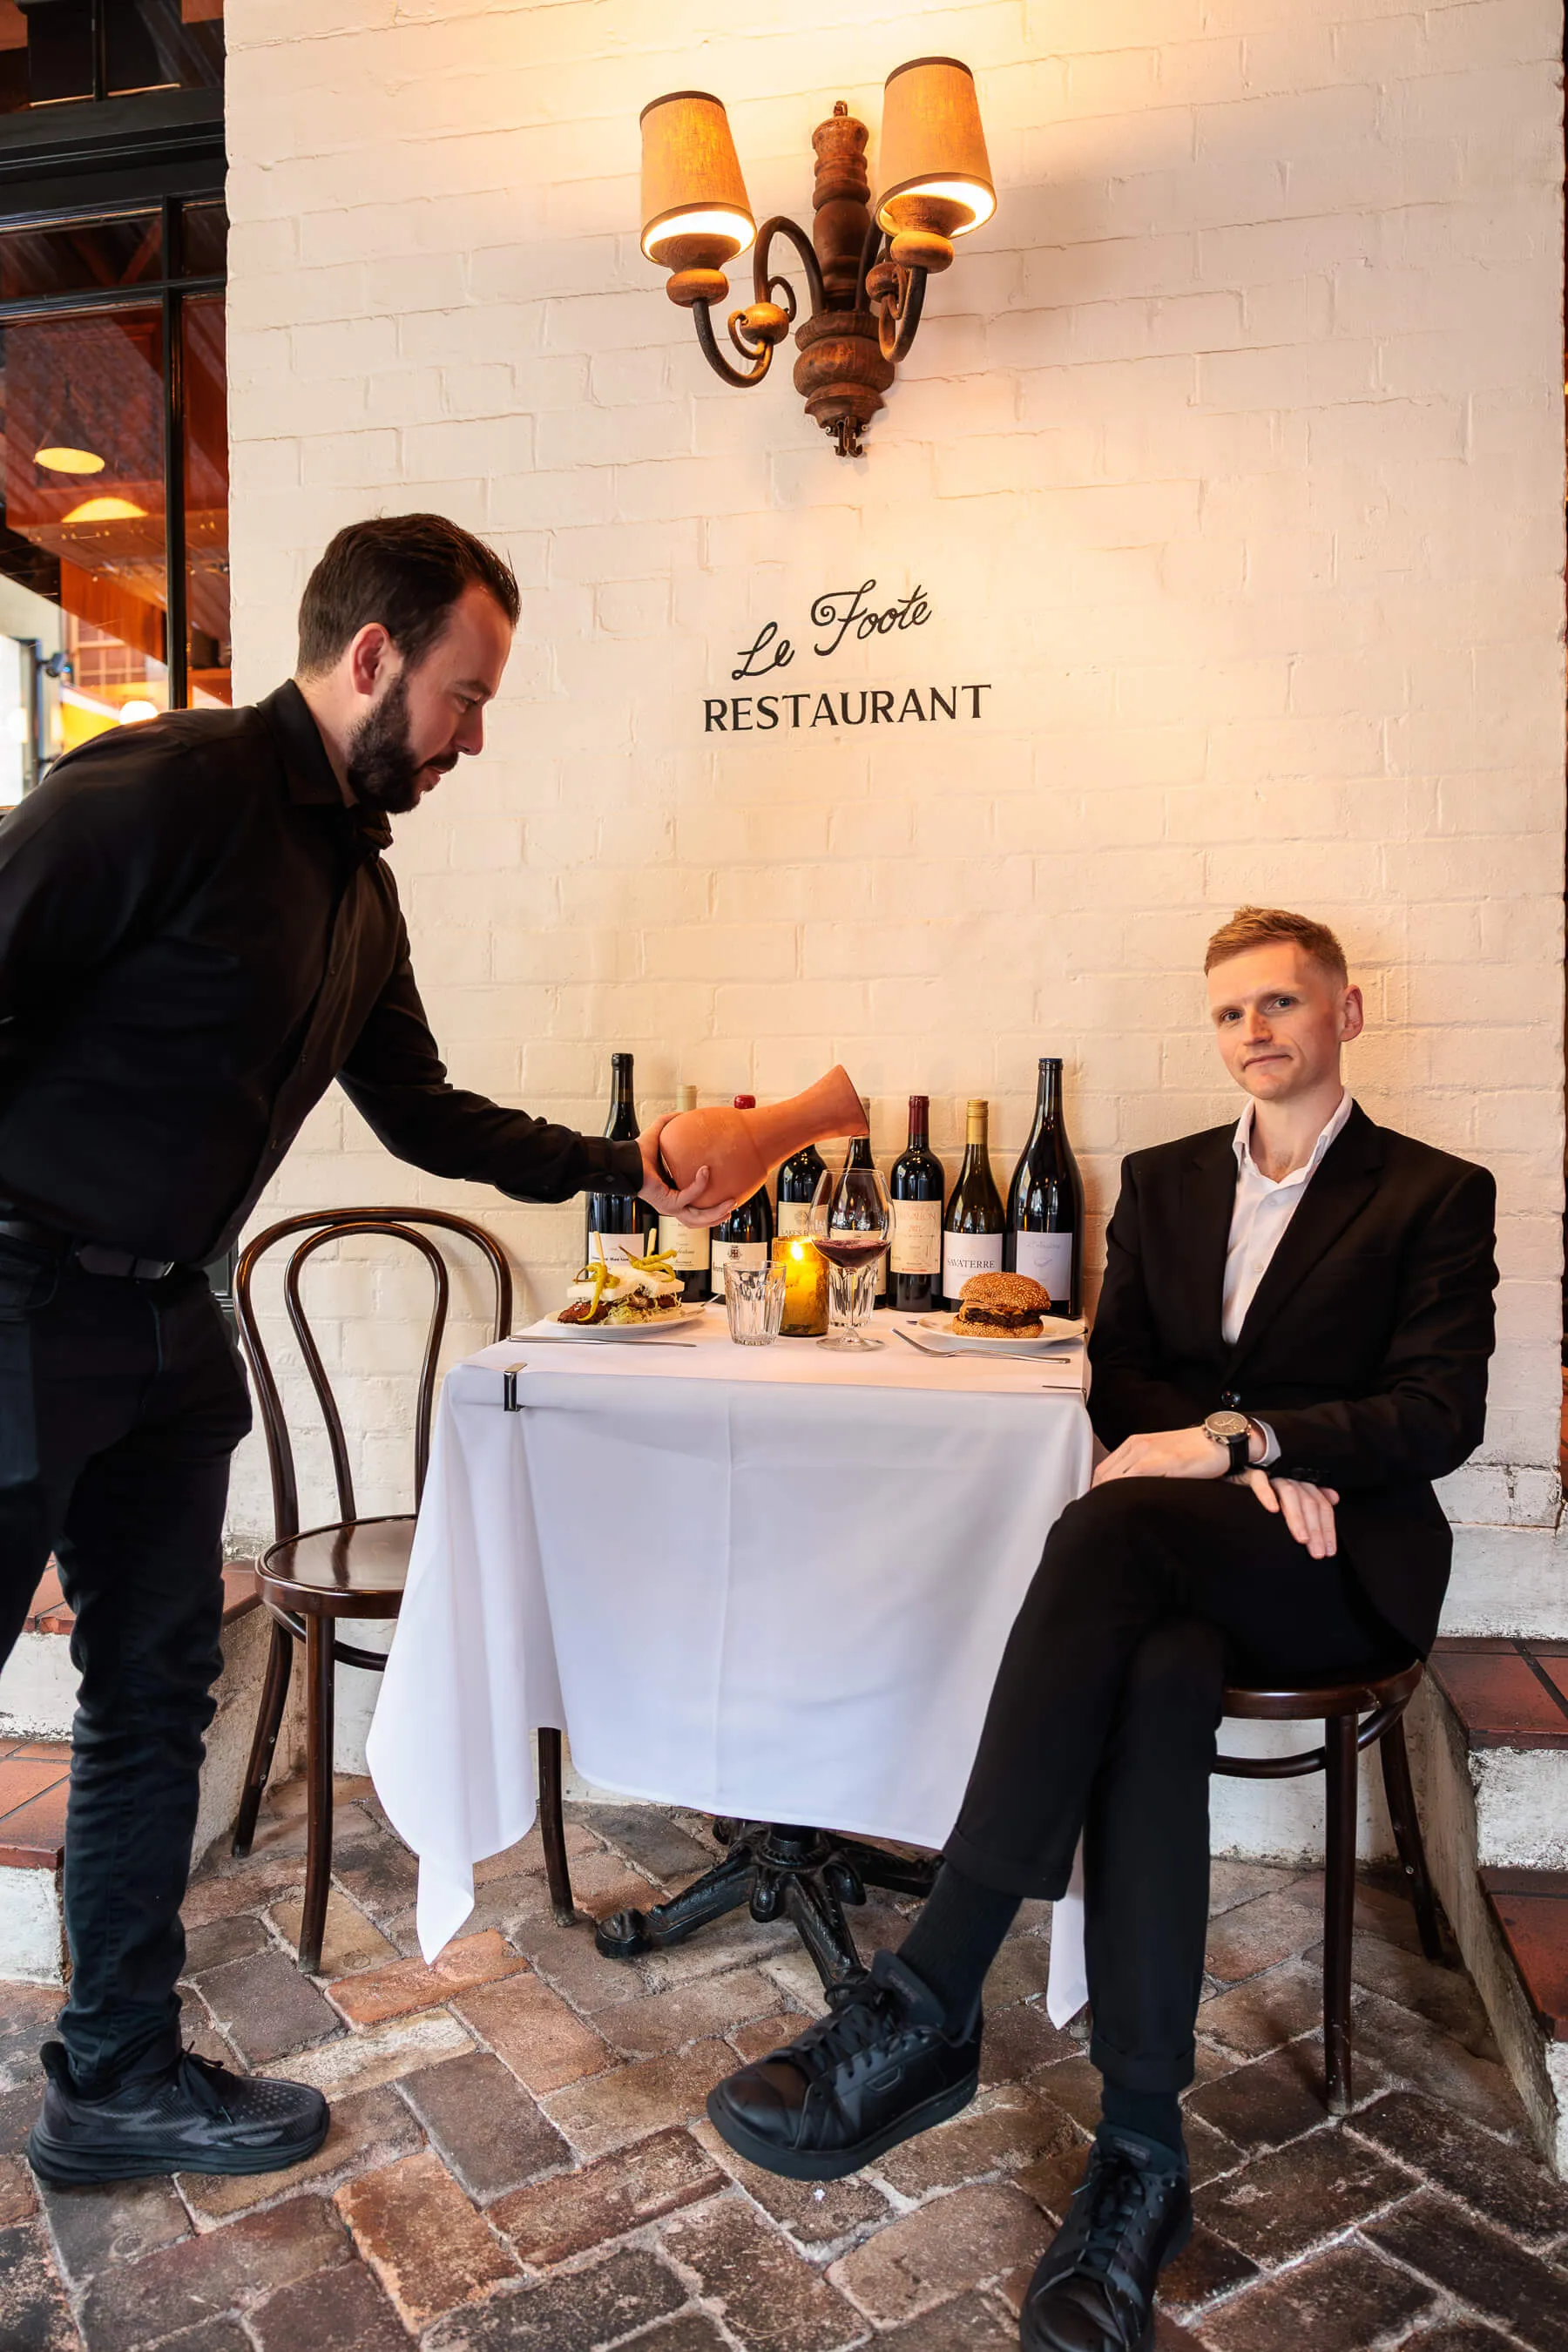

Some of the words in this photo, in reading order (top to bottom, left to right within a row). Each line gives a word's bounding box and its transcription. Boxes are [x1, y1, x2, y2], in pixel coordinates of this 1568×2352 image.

[731, 620, 795, 681] Le
[810, 578, 932, 656] Foote
[702, 684, 992, 733] RESTAURANT
[947, 1258, 997, 1269] SAVATERRE
